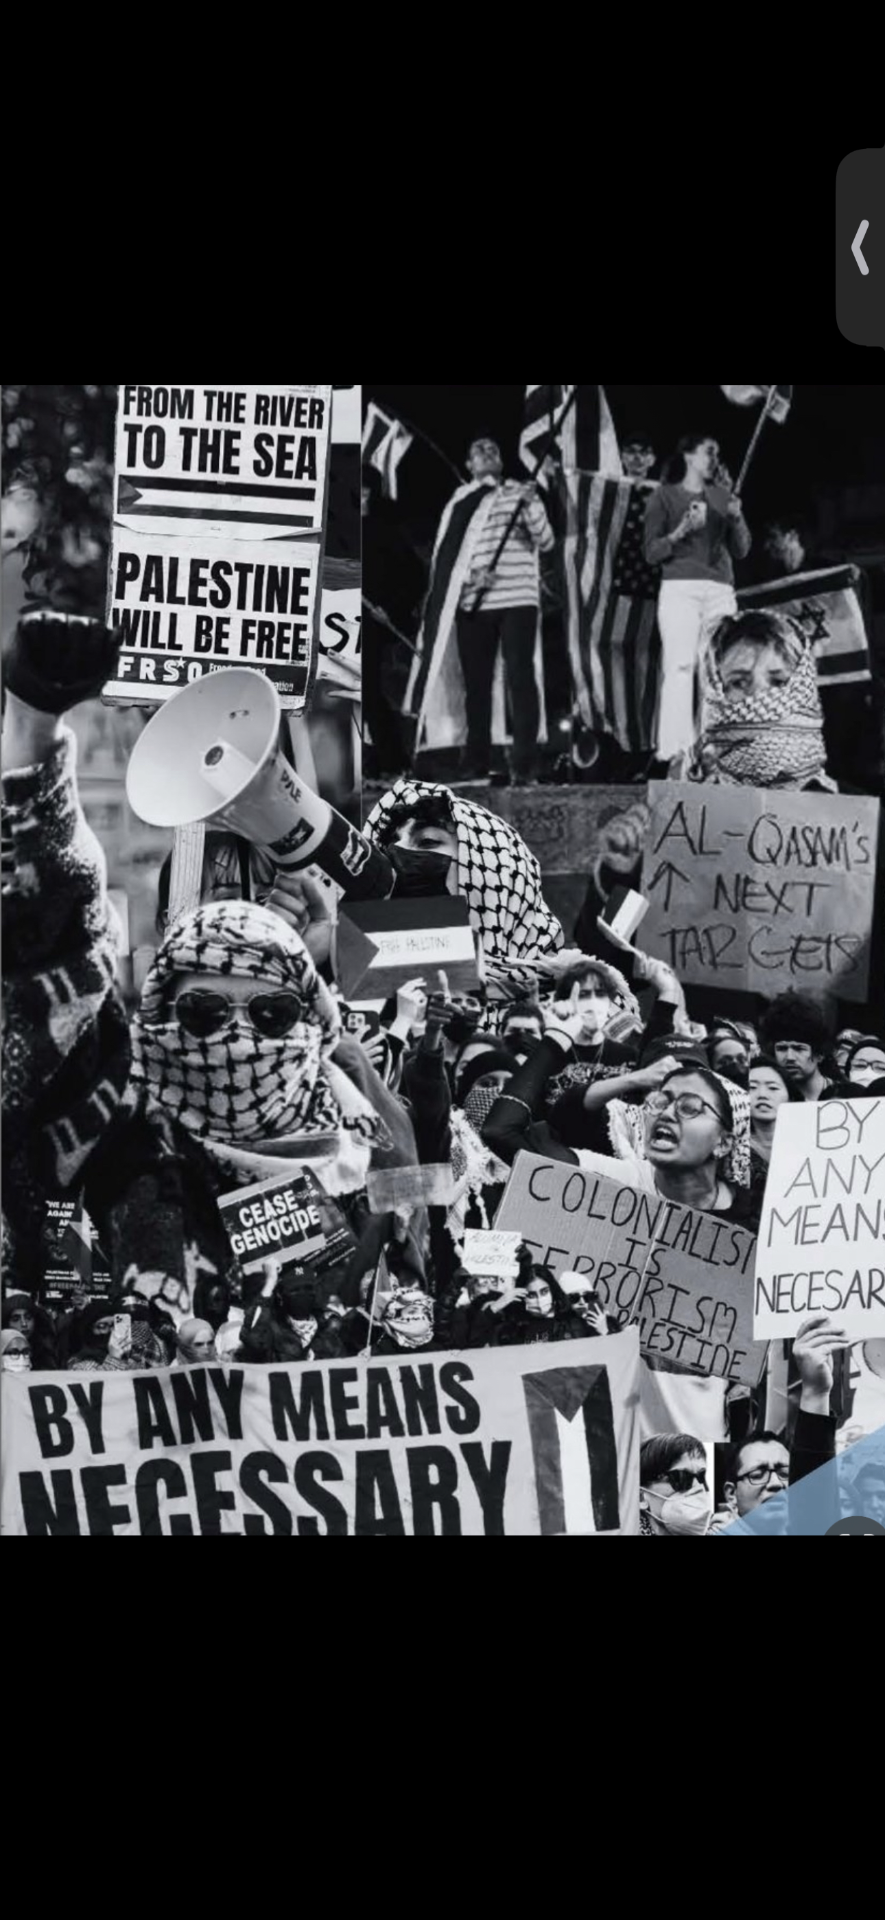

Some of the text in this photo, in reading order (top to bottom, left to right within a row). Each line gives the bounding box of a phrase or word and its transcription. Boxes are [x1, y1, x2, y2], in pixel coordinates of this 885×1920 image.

[123, 385, 325, 430] FROM THE RIVER
[123, 423, 317, 481] TO THE SEA
[115, 552, 311, 616] PALESTINE
[112, 608, 308, 662] WILL BE FREE
[713, 873, 832, 917] NEXT
[816, 1101, 881, 1150] BY
[783, 1152, 885, 1198] ANY
[230, 1204, 321, 1255] GENOCIDE
[238, 1189, 299, 1229] CEASE
[768, 1199, 885, 1247] MEAN
[618, 1237, 666, 1277] IS
[28, 1361, 482, 1459] BY ANY MEANS
[18, 1440, 513, 1536] NECESSARY
